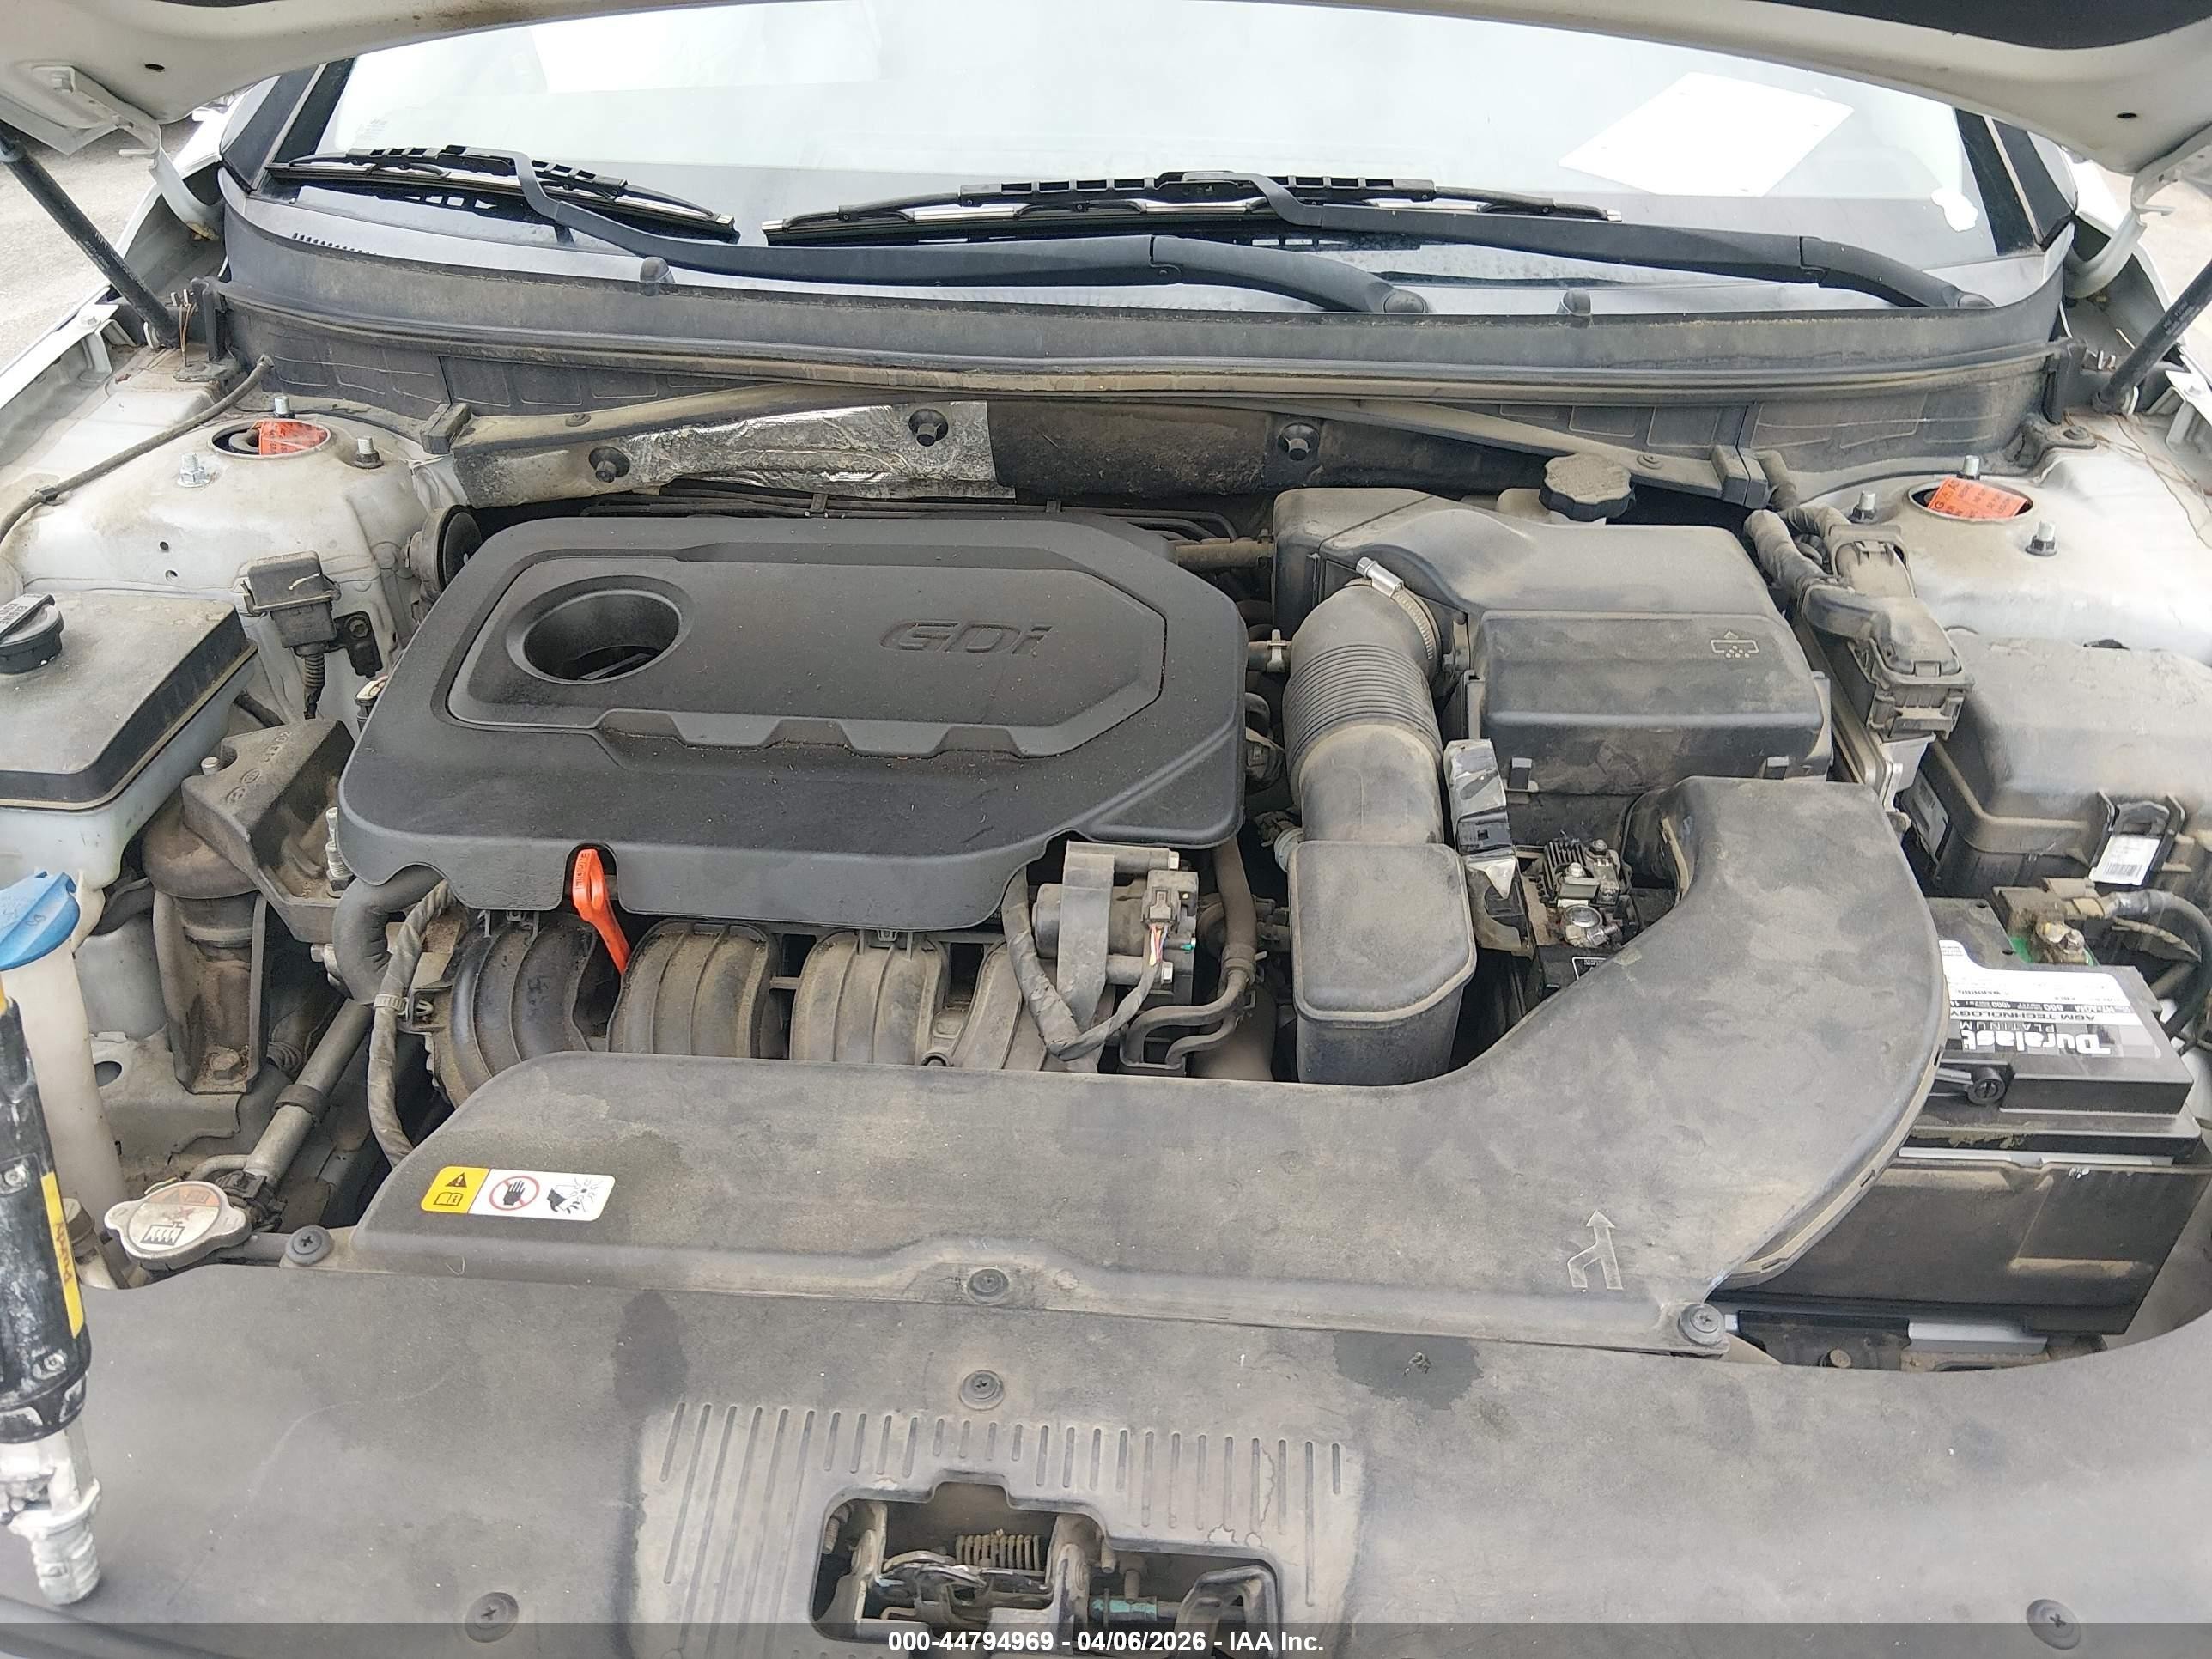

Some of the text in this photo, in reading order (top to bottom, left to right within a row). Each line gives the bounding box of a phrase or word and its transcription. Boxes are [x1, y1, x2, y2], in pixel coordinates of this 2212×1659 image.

[878, 618, 1054, 656] GDi
[1950, 1010, 2057, 1021] TECHNOLOGY
[1959, 1020, 2057, 1033] PLATINUM
[1960, 1030, 2112, 1054] Duralast
